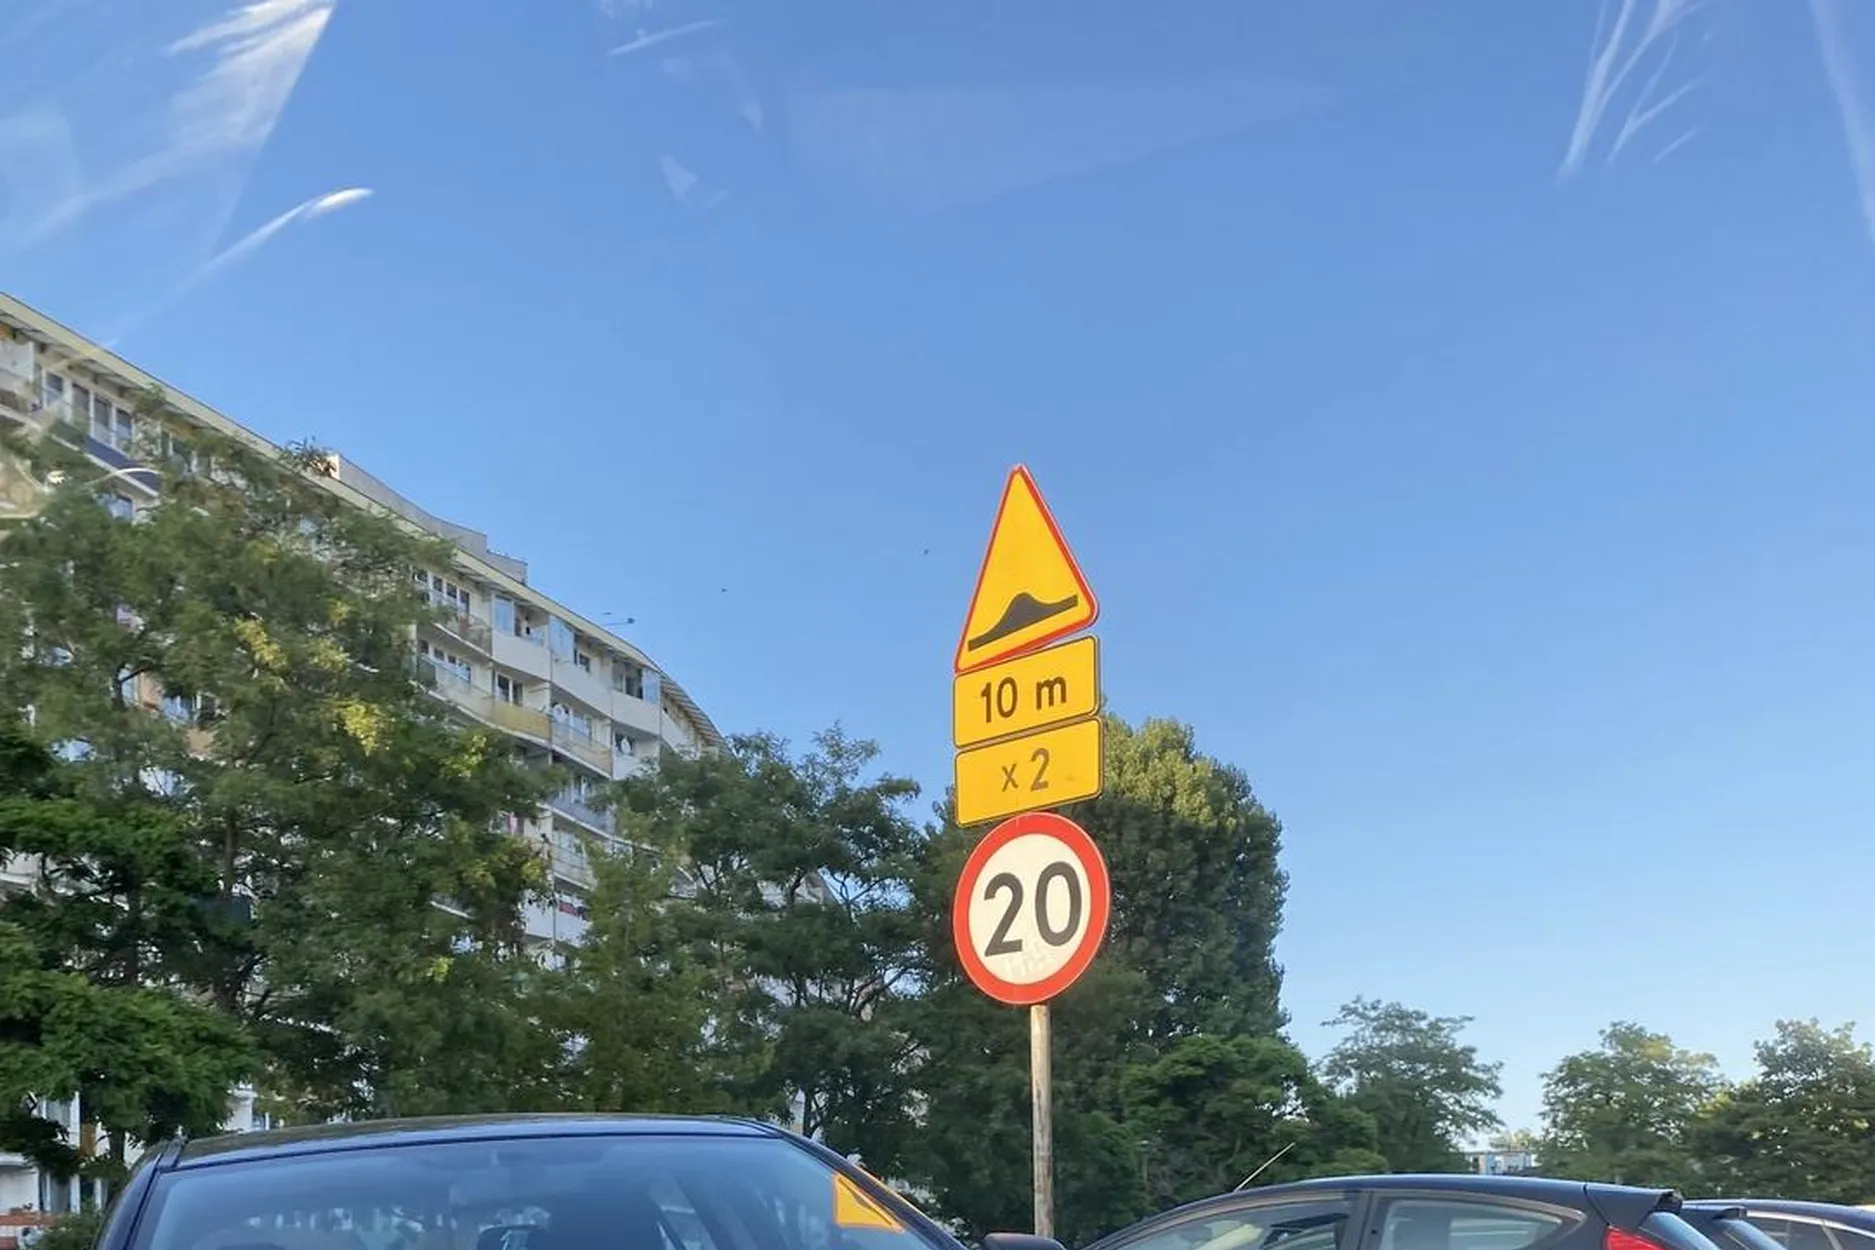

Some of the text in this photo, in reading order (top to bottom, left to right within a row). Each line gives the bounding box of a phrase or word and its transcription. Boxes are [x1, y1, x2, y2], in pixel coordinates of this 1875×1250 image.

[981, 677, 1067, 723] 10 m
[1030, 748, 1050, 792] 2
[984, 861, 1082, 957] 20
